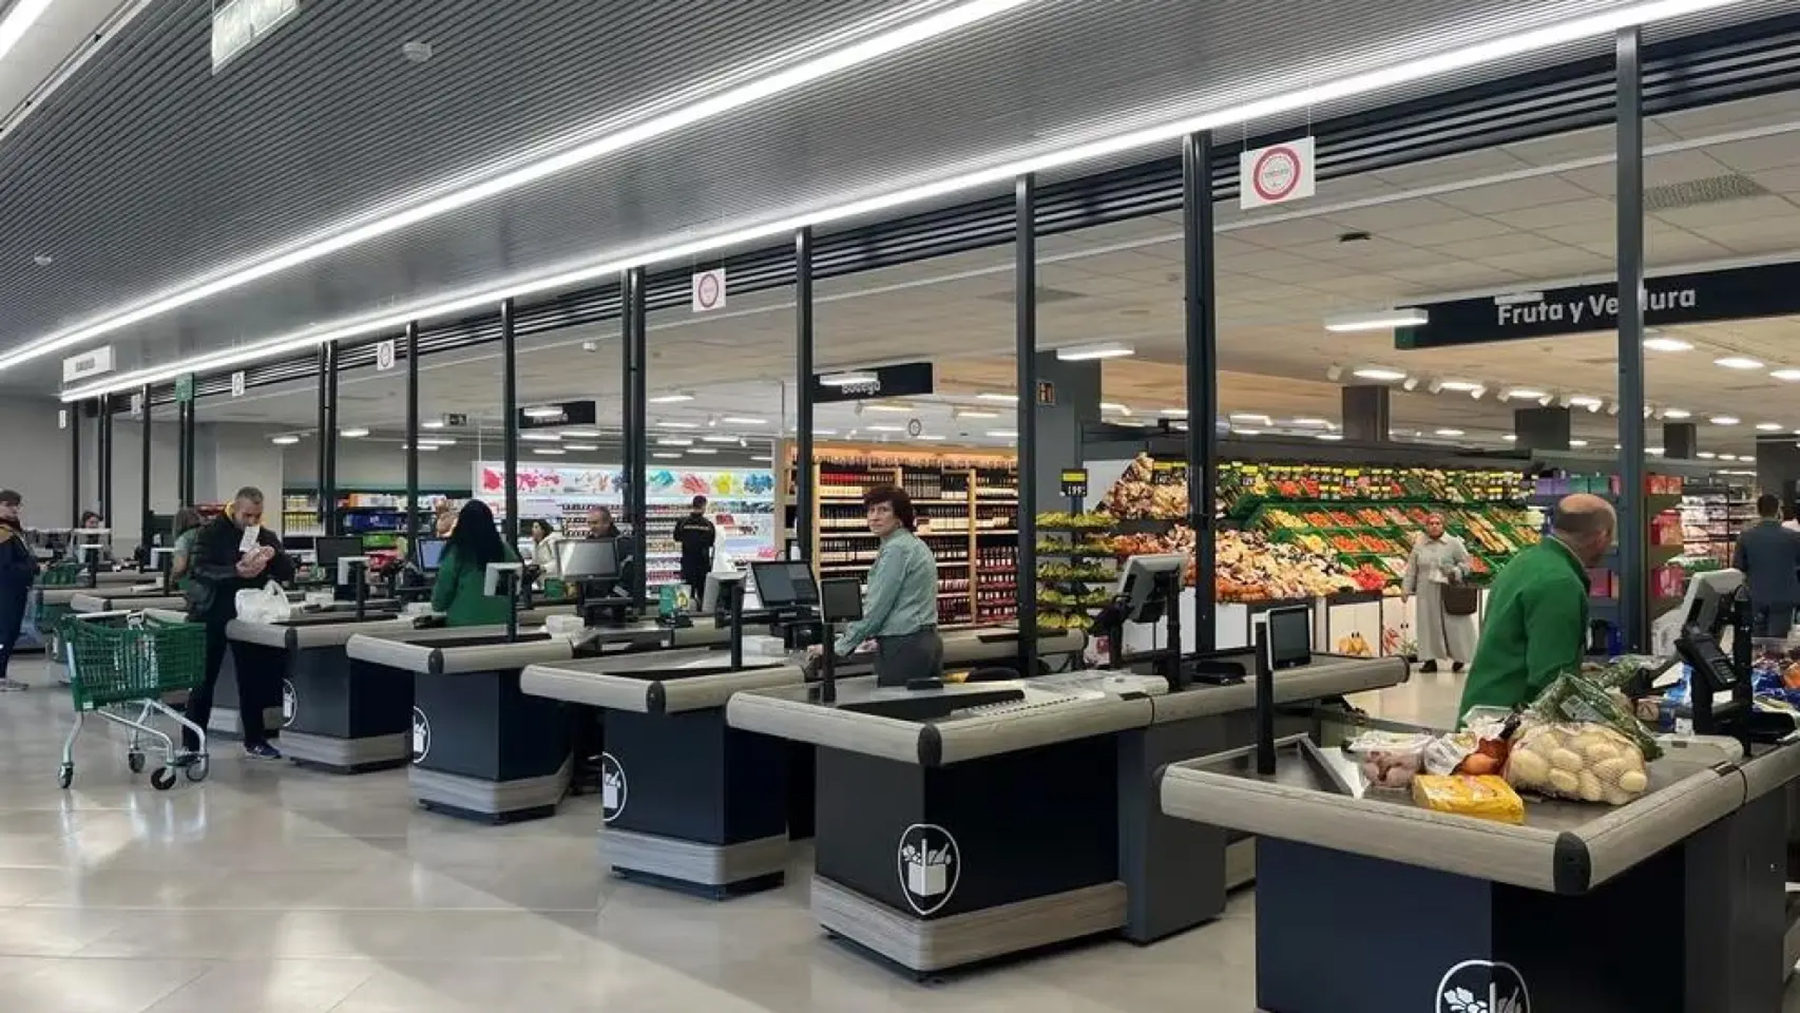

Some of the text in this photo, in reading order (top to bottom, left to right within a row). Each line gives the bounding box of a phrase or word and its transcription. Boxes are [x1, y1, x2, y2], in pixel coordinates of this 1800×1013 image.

[1497, 287, 1696, 326] Fruta y Veura
